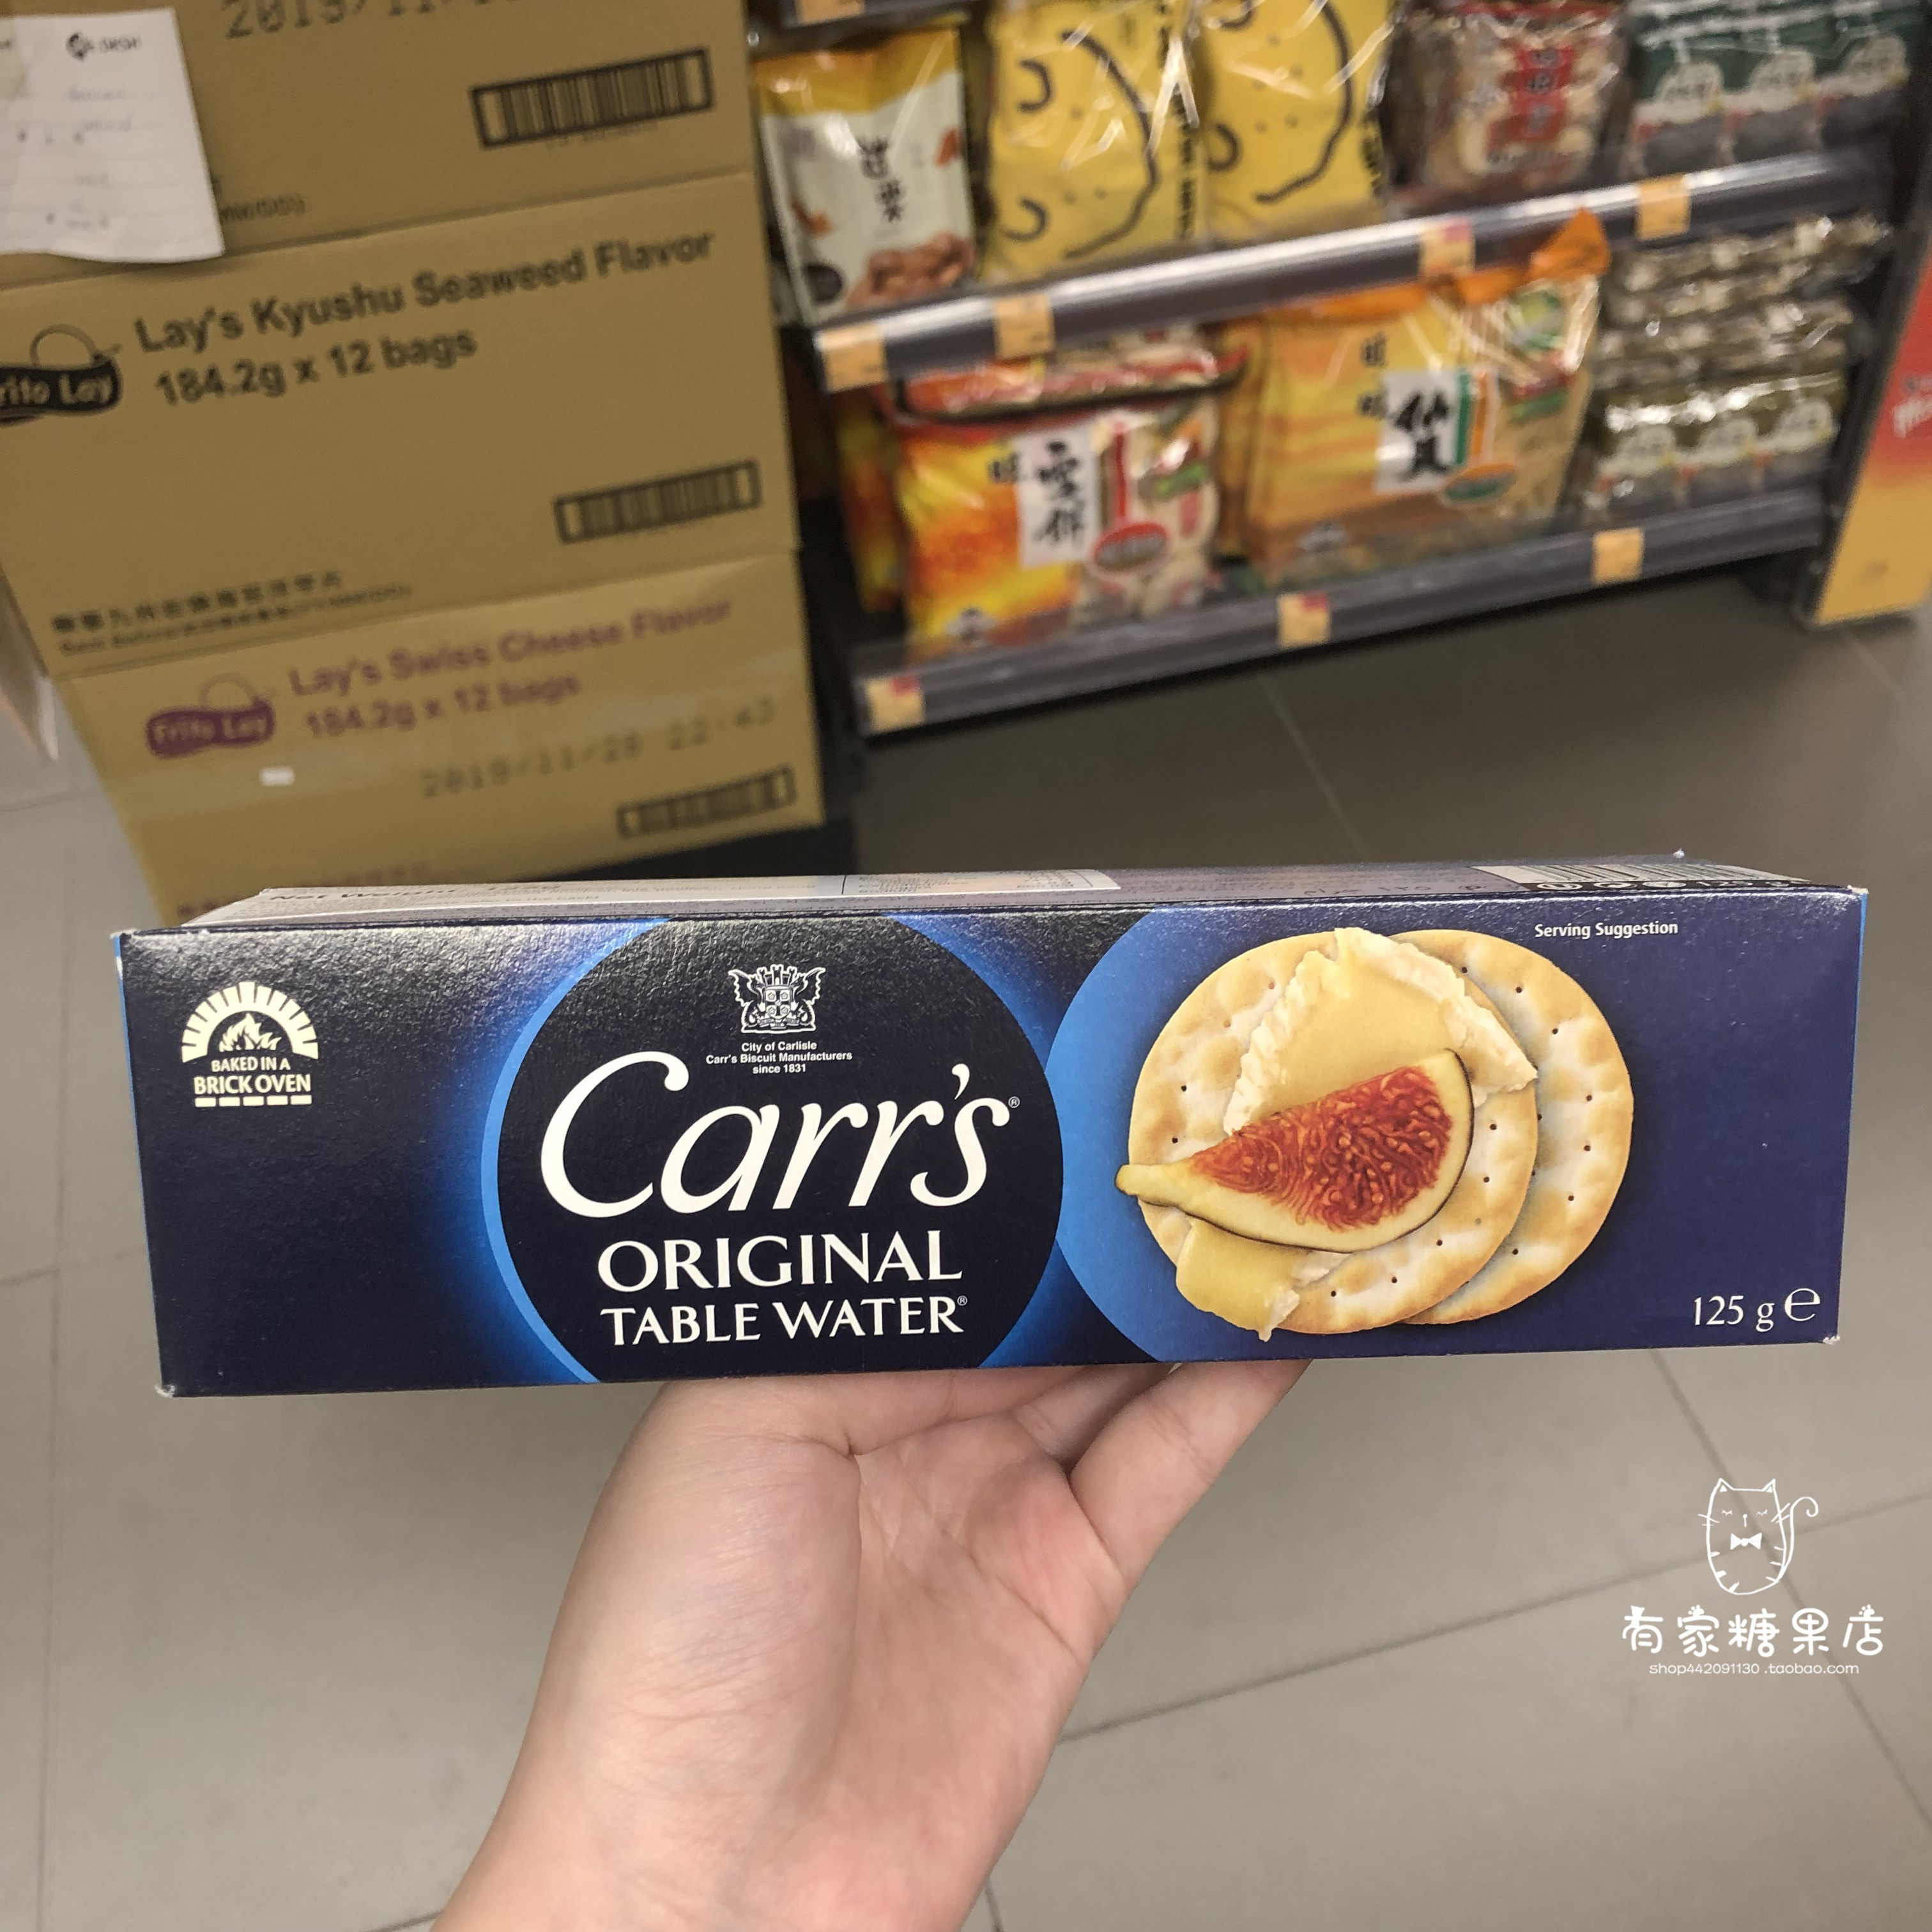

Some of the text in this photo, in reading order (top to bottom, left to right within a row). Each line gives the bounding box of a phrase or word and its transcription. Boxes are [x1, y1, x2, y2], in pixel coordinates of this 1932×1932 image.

[135, 231, 714, 353] Lay's Kyushu Seaweed Flavor
[157, 359, 286, 405] 184.2g
[328, 339, 373, 377] 12
[380, 328, 477, 369] bags
[289, 601, 732, 697] Lay's Swiss Cheese Flavor
[454, 681, 491, 714] 12
[499, 675, 583, 707] bags
[1535, 921, 1679, 940] Serving Suggestion
[211, 1056, 291, 1072] BAKED IN A
[705, 1052, 852, 1064] Carr's Biscuit Manufacturers
[742, 1041, 817, 1054] City of Carlisle
[194, 1073, 311, 1094] BRICK OVEN
[753, 1063, 806, 1074] since 1831
[597, 1230, 963, 1292] ORIGINAL
[600, 1303, 761, 1346] TABLE
[1694, 1295, 1744, 1326] 125
[1756, 1303, 1775, 1332] g
